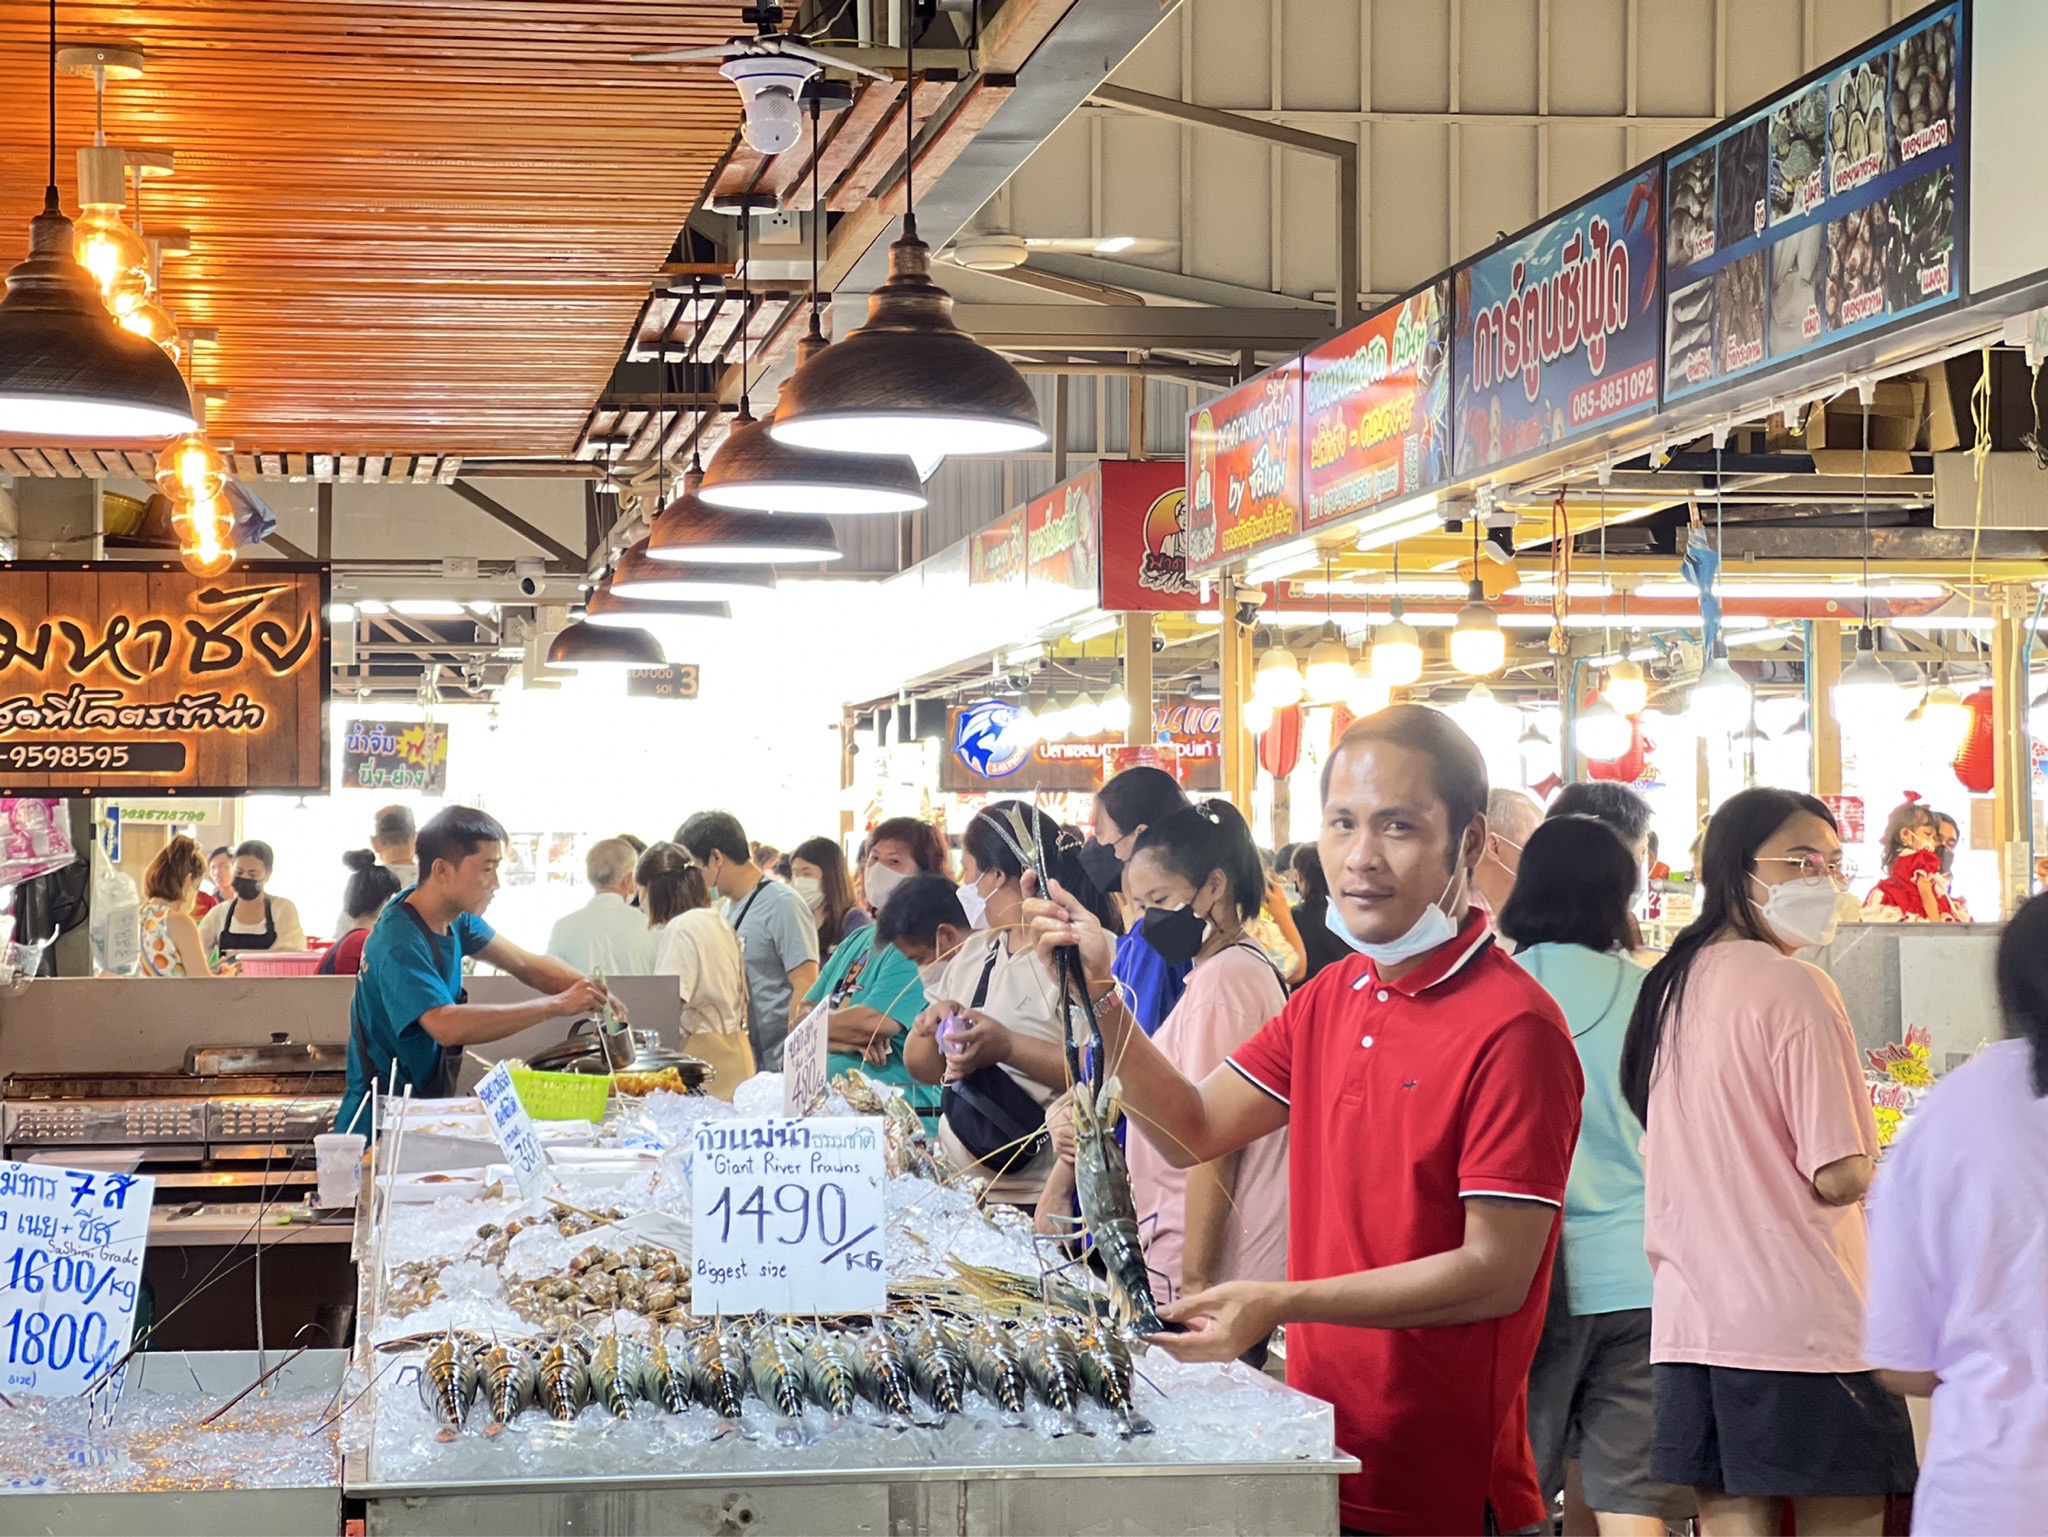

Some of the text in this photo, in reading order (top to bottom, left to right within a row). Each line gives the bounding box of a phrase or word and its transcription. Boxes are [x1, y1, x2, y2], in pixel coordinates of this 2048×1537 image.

[1473, 216, 1628, 400] การ์ตูนซีฟู้ด
[1573, 367, 1654, 422] 085-8851092
[1228, 475, 1246, 517] by
[656, 666, 698, 696] SOI 3
[346, 723, 396, 755] น้ำจิ้ม
[1878, 1086, 1907, 1109] sale
[812, 1126, 876, 1150] ธรรมชาติ
[714, 1151, 860, 1175] Giant River Prawns
[65, 1170, 95, 1208] 7
[103, 1172, 140, 1209] สี
[100, 1244, 139, 1266] Grade
[697, 1258, 787, 1284] Biggest size
